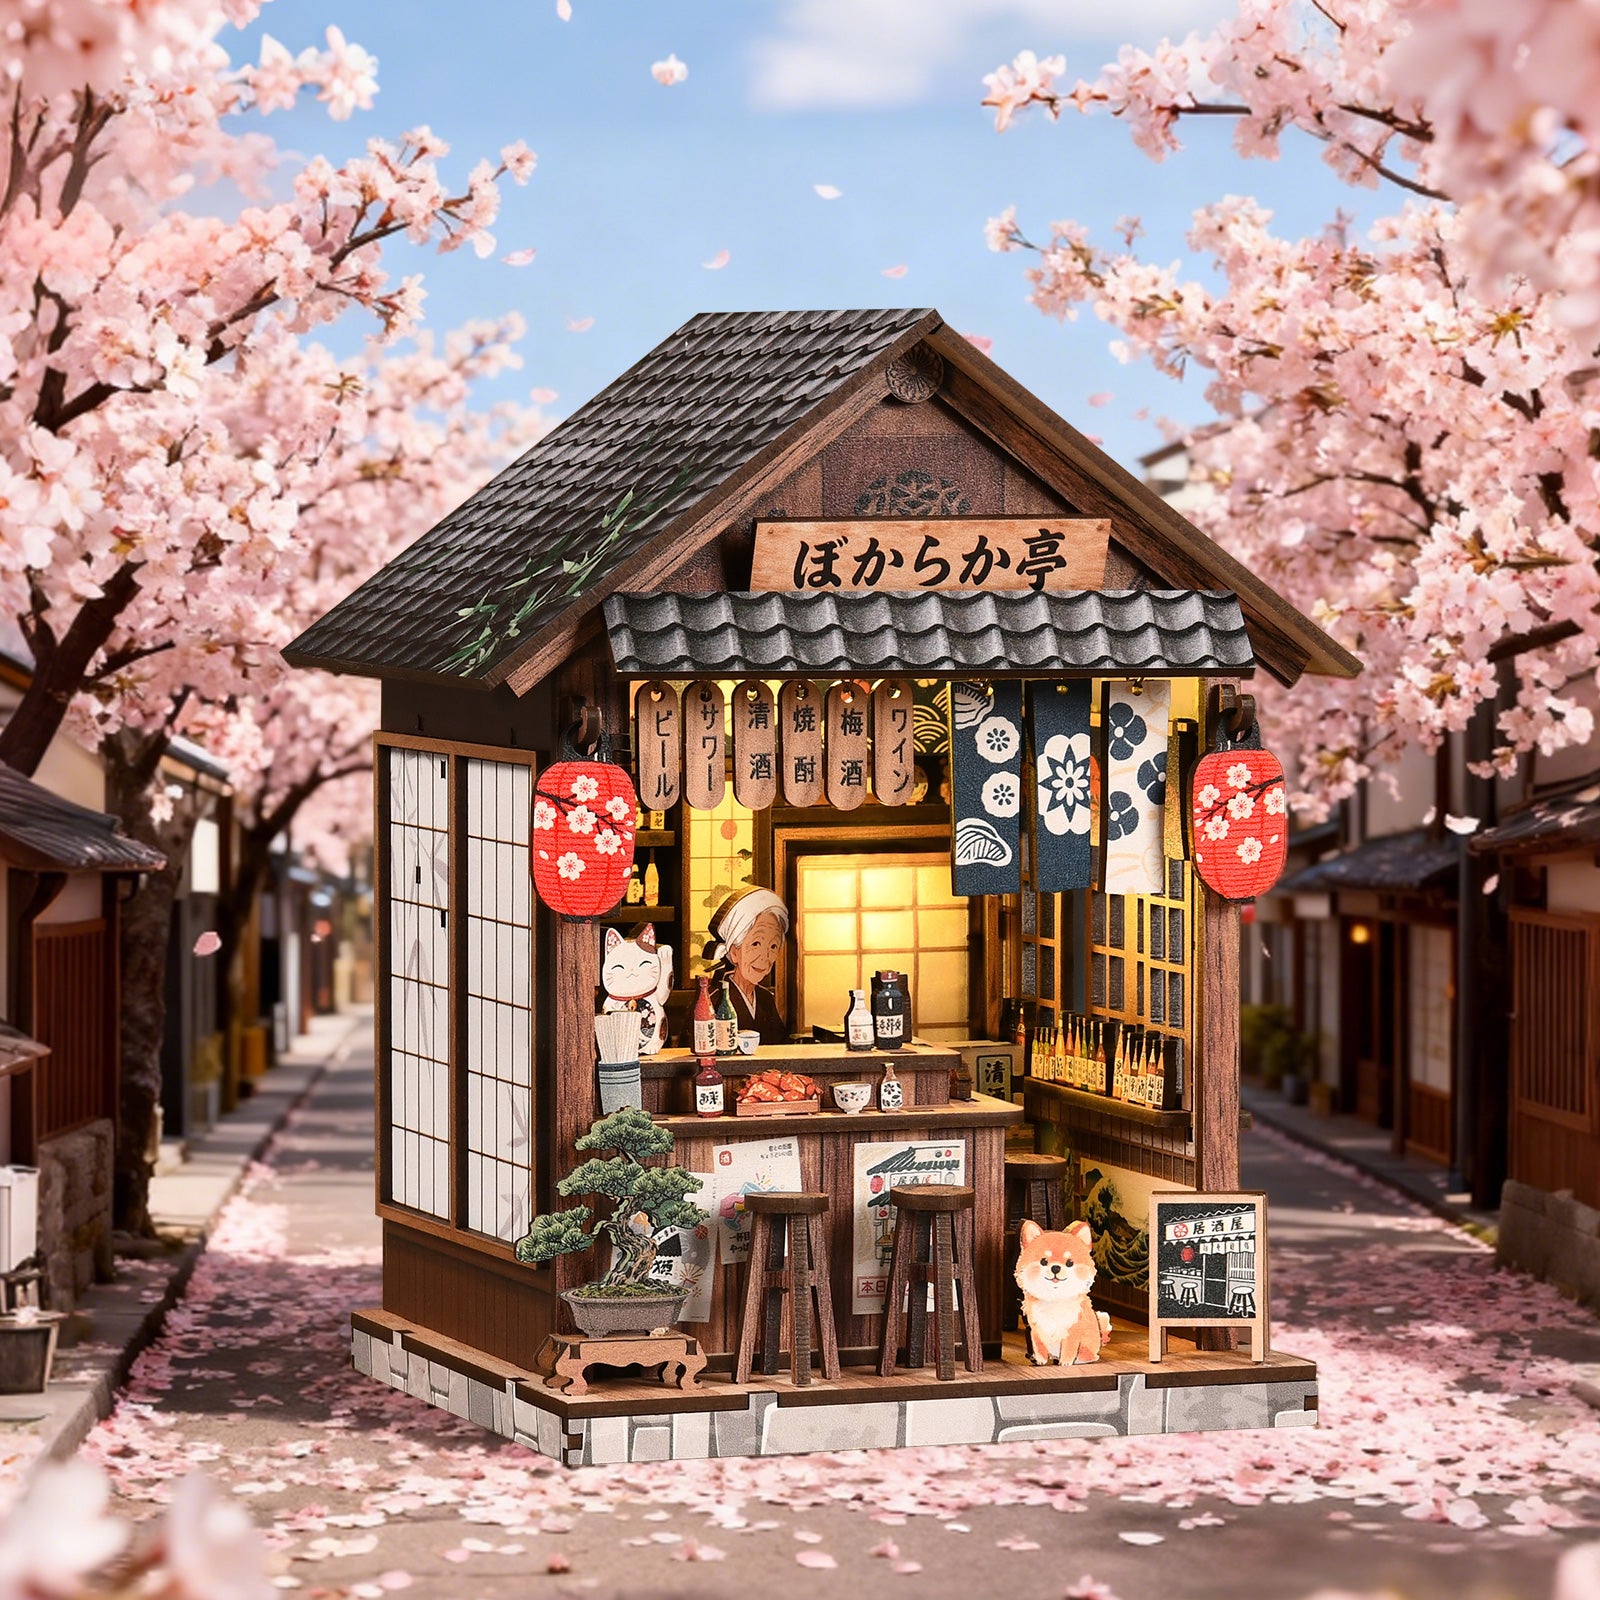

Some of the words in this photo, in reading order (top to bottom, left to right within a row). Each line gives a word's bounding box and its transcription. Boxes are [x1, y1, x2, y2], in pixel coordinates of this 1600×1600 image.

[794, 528, 1067, 591] ぼからか亭
[655, 709, 674, 798] ビール
[700, 703, 719, 792] サワー
[747, 701, 772, 780] 清酒
[792, 704, 816, 784] 焼酎
[840, 707, 864, 787] 梅酒
[891, 708, 910, 794] ワイン
[1192, 1216, 1244, 1235] 居酒屋
[861, 1280, 886, 1293] 本日
